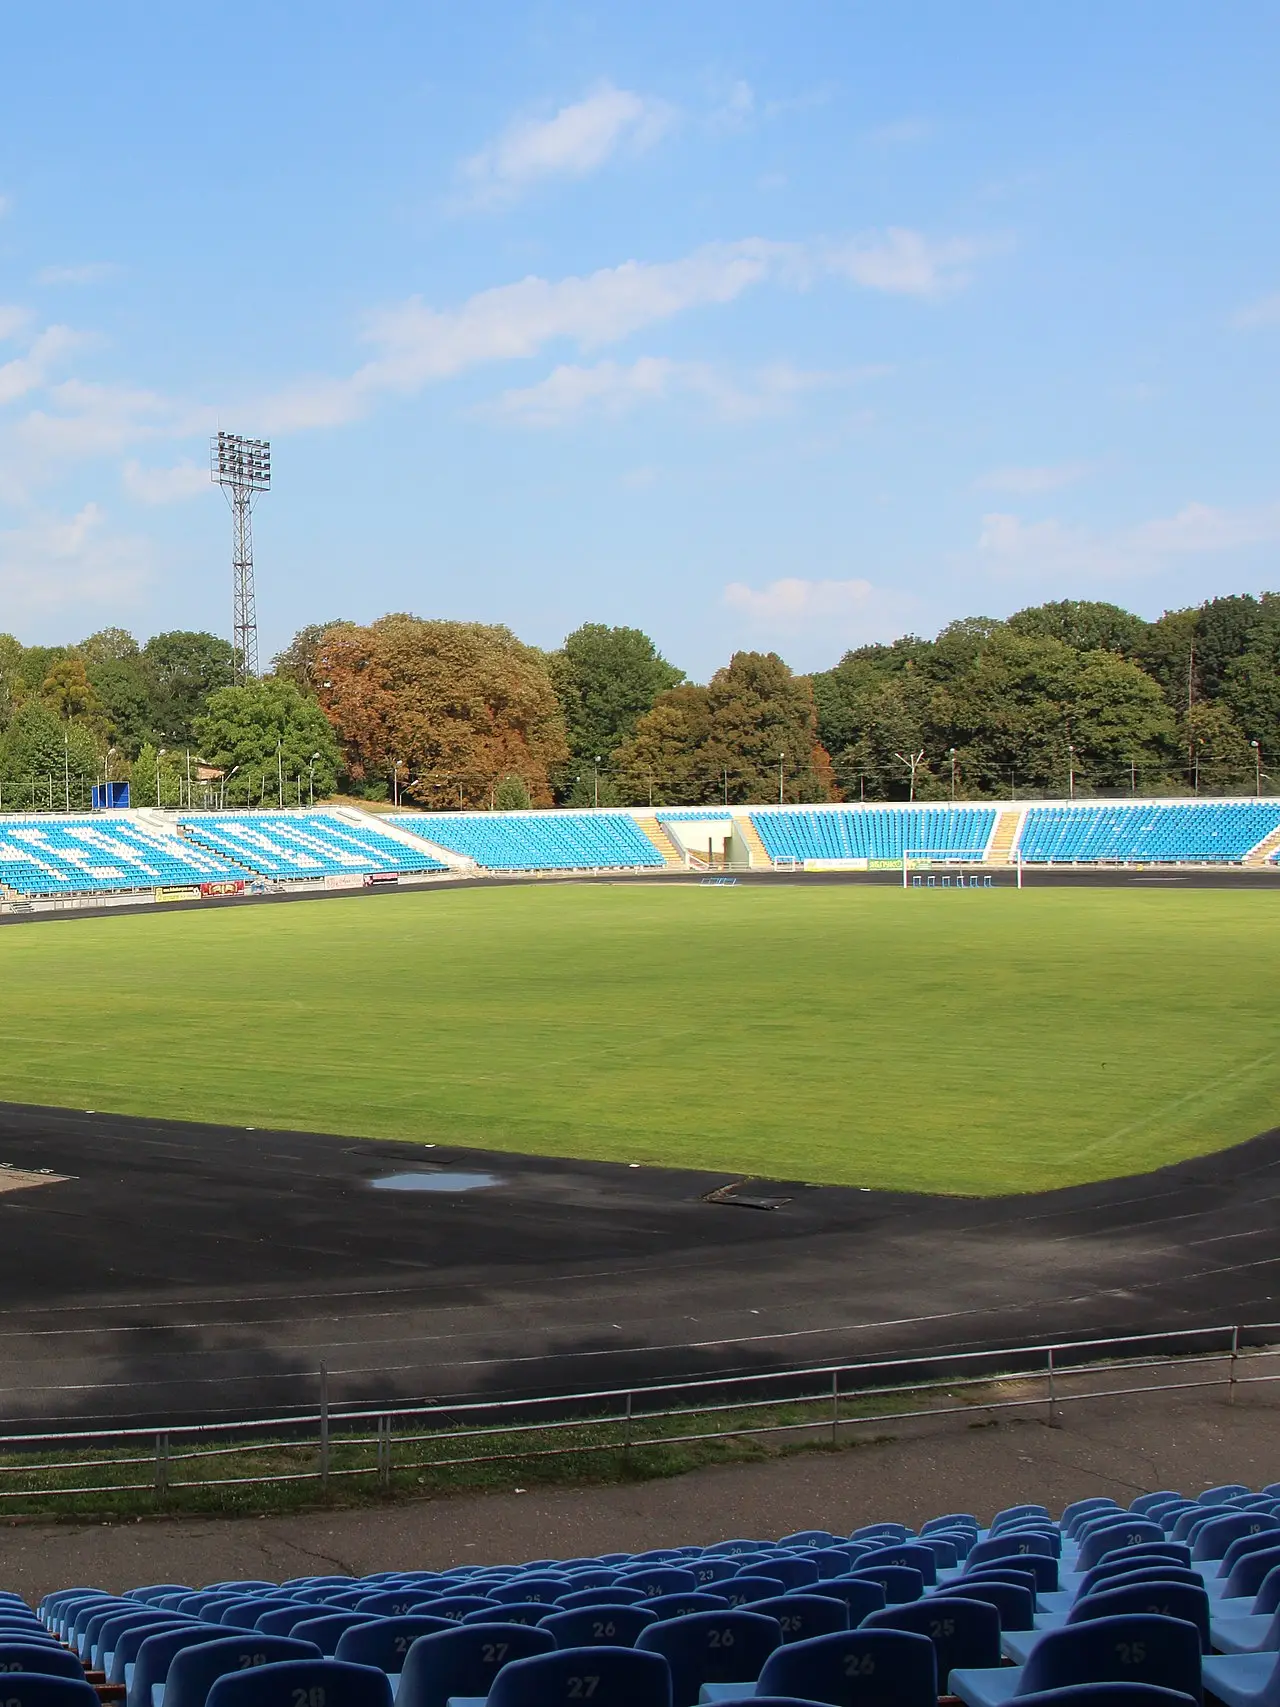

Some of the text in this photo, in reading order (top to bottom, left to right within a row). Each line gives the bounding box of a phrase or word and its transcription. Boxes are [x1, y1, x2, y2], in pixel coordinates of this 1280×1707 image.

[1249, 1524, 1261, 1534] 19
[808, 1539, 816, 1547] 19
[1127, 1534, 1142, 1545] 20
[699, 1569, 714, 1581] 23
[730, 1594, 747, 1604] 24
[592, 1621, 615, 1638] 26
[781, 1616, 802, 1631] 25
[929, 1619, 955, 1638] 25
[707, 1628, 735, 1648] 26
[482, 1643, 509, 1662] 27
[1114, 1642, 1146, 1664] 25
[844, 1654, 875, 1676] 26
[567, 1675, 600, 1698] 27
